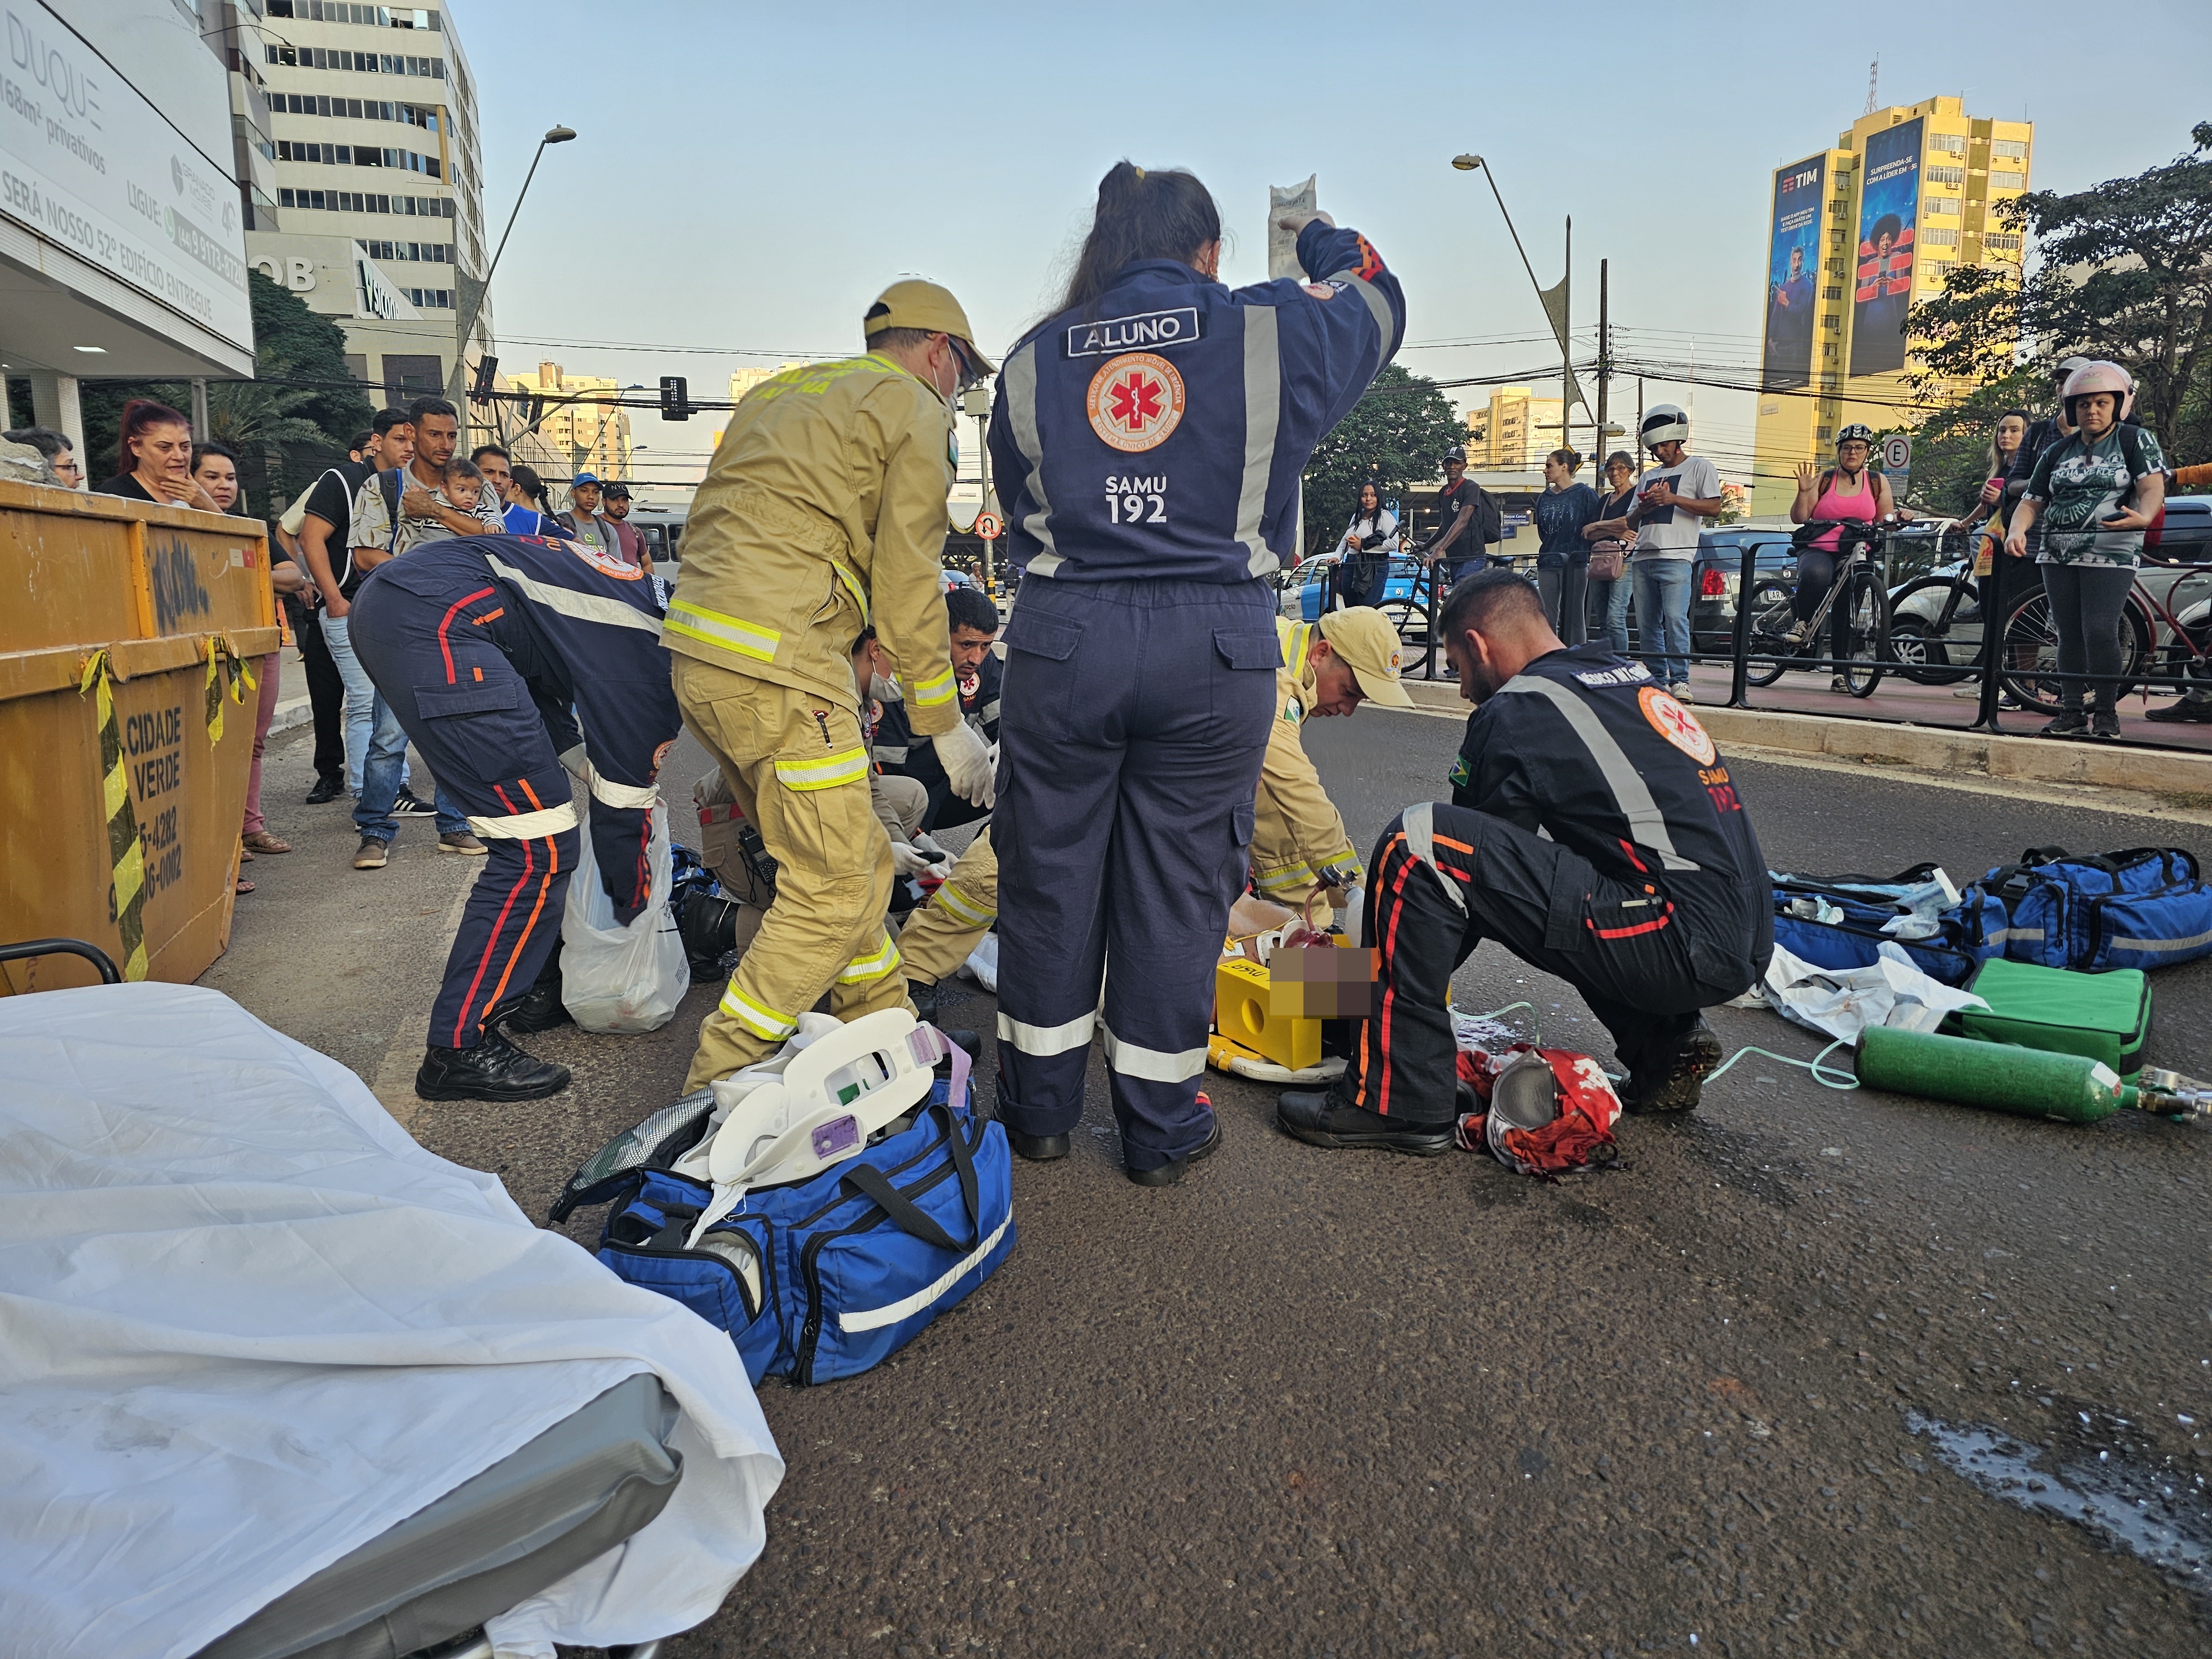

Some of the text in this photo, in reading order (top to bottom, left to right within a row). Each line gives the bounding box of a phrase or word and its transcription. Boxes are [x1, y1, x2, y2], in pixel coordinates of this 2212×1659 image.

[6, 9, 102, 132] DUQUE
[46, 117, 106, 175] privativos
[1796, 168, 1817, 189] TIM
[1866, 176, 1878, 185] COM
[1883, 169, 1898, 180] LÍDER
[1898, 166, 1907, 175] EM
[1870, 155, 1913, 175] SURPREENDA-SE
[127, 180, 162, 228] LIGUE:
[2, 170, 44, 222] SERÁ
[45, 197, 94, 250] NOSSO
[119, 243, 164, 291] EDIFÍCIO
[167, 271, 213, 321] ENTREGUE
[1083, 317, 1180, 348] ALUNO
[1102, 355, 1145, 377] ATENDIMENTO
[1097, 421, 1121, 447] SISTEMA
[1893, 445, 1901, 461] E
[1105, 476, 1167, 494] SAMU
[2083, 467, 2116, 477] VERDE
[1105, 494, 1167, 524] 192
[127, 706, 181, 757] CIDADE
[134, 750, 180, 803] VERDE
[1708, 785, 1742, 813] 192
